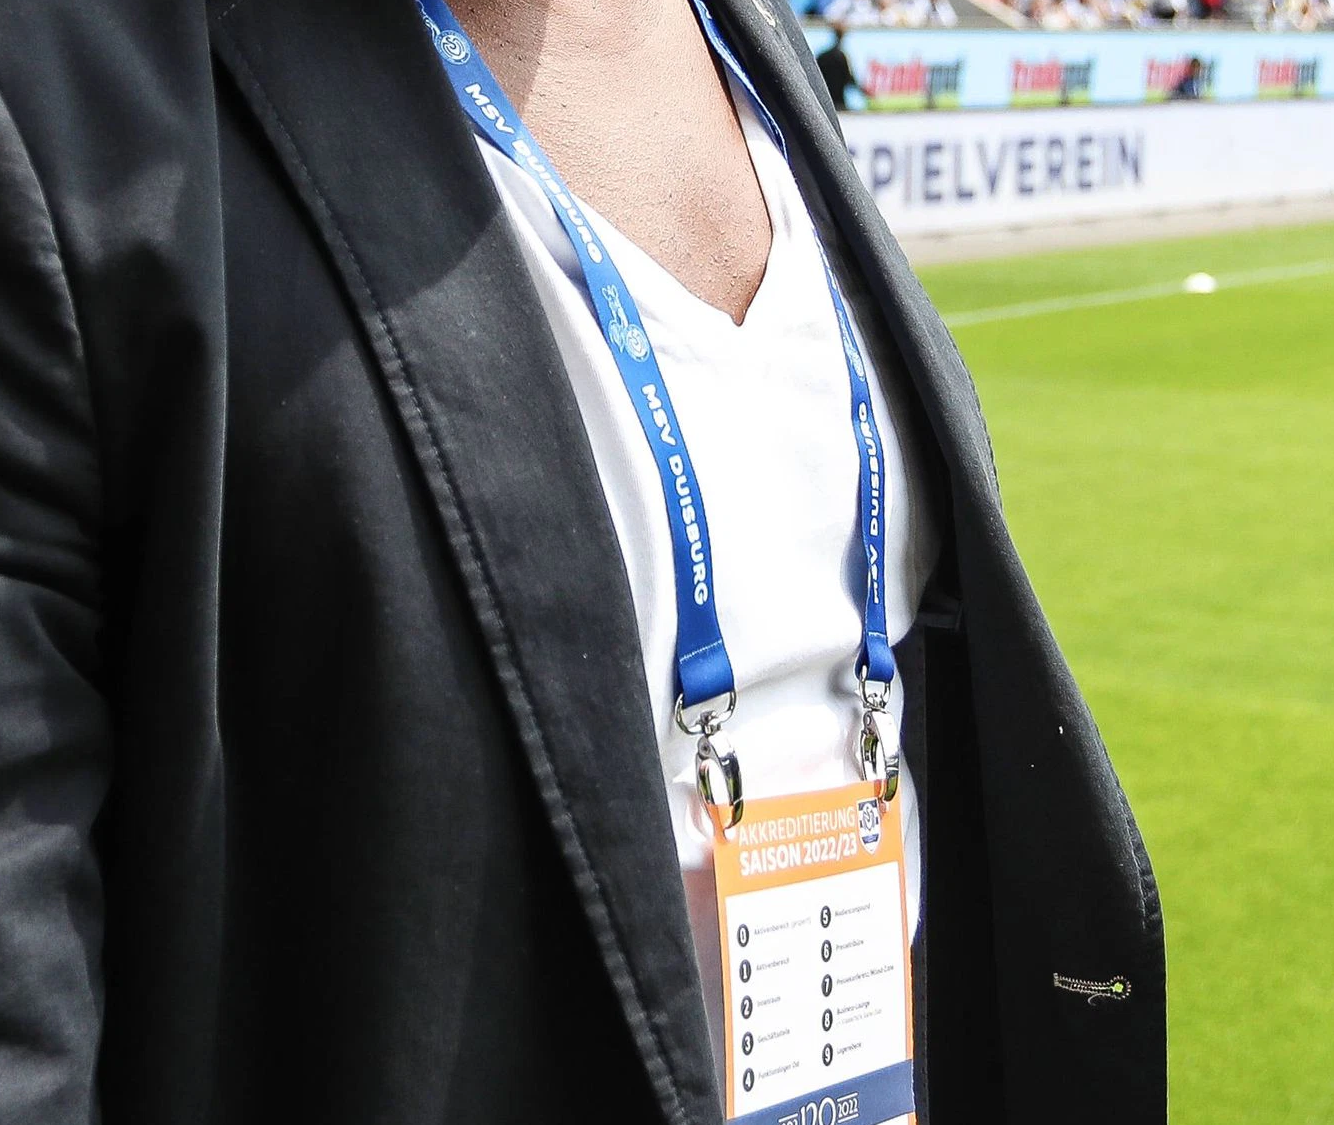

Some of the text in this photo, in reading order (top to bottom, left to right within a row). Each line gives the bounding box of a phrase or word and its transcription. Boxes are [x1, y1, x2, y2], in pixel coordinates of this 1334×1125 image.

[465, 82, 515, 135] MSV
[848, 129, 1146, 206] PIELVEREIN
[641, 383, 708, 606] MSV DUISBURG
[739, 805, 856, 847] AKKREDITIERUNG
[740, 832, 858, 876] SAISON 2022/23
[838, 1096, 859, 1117] 2022
